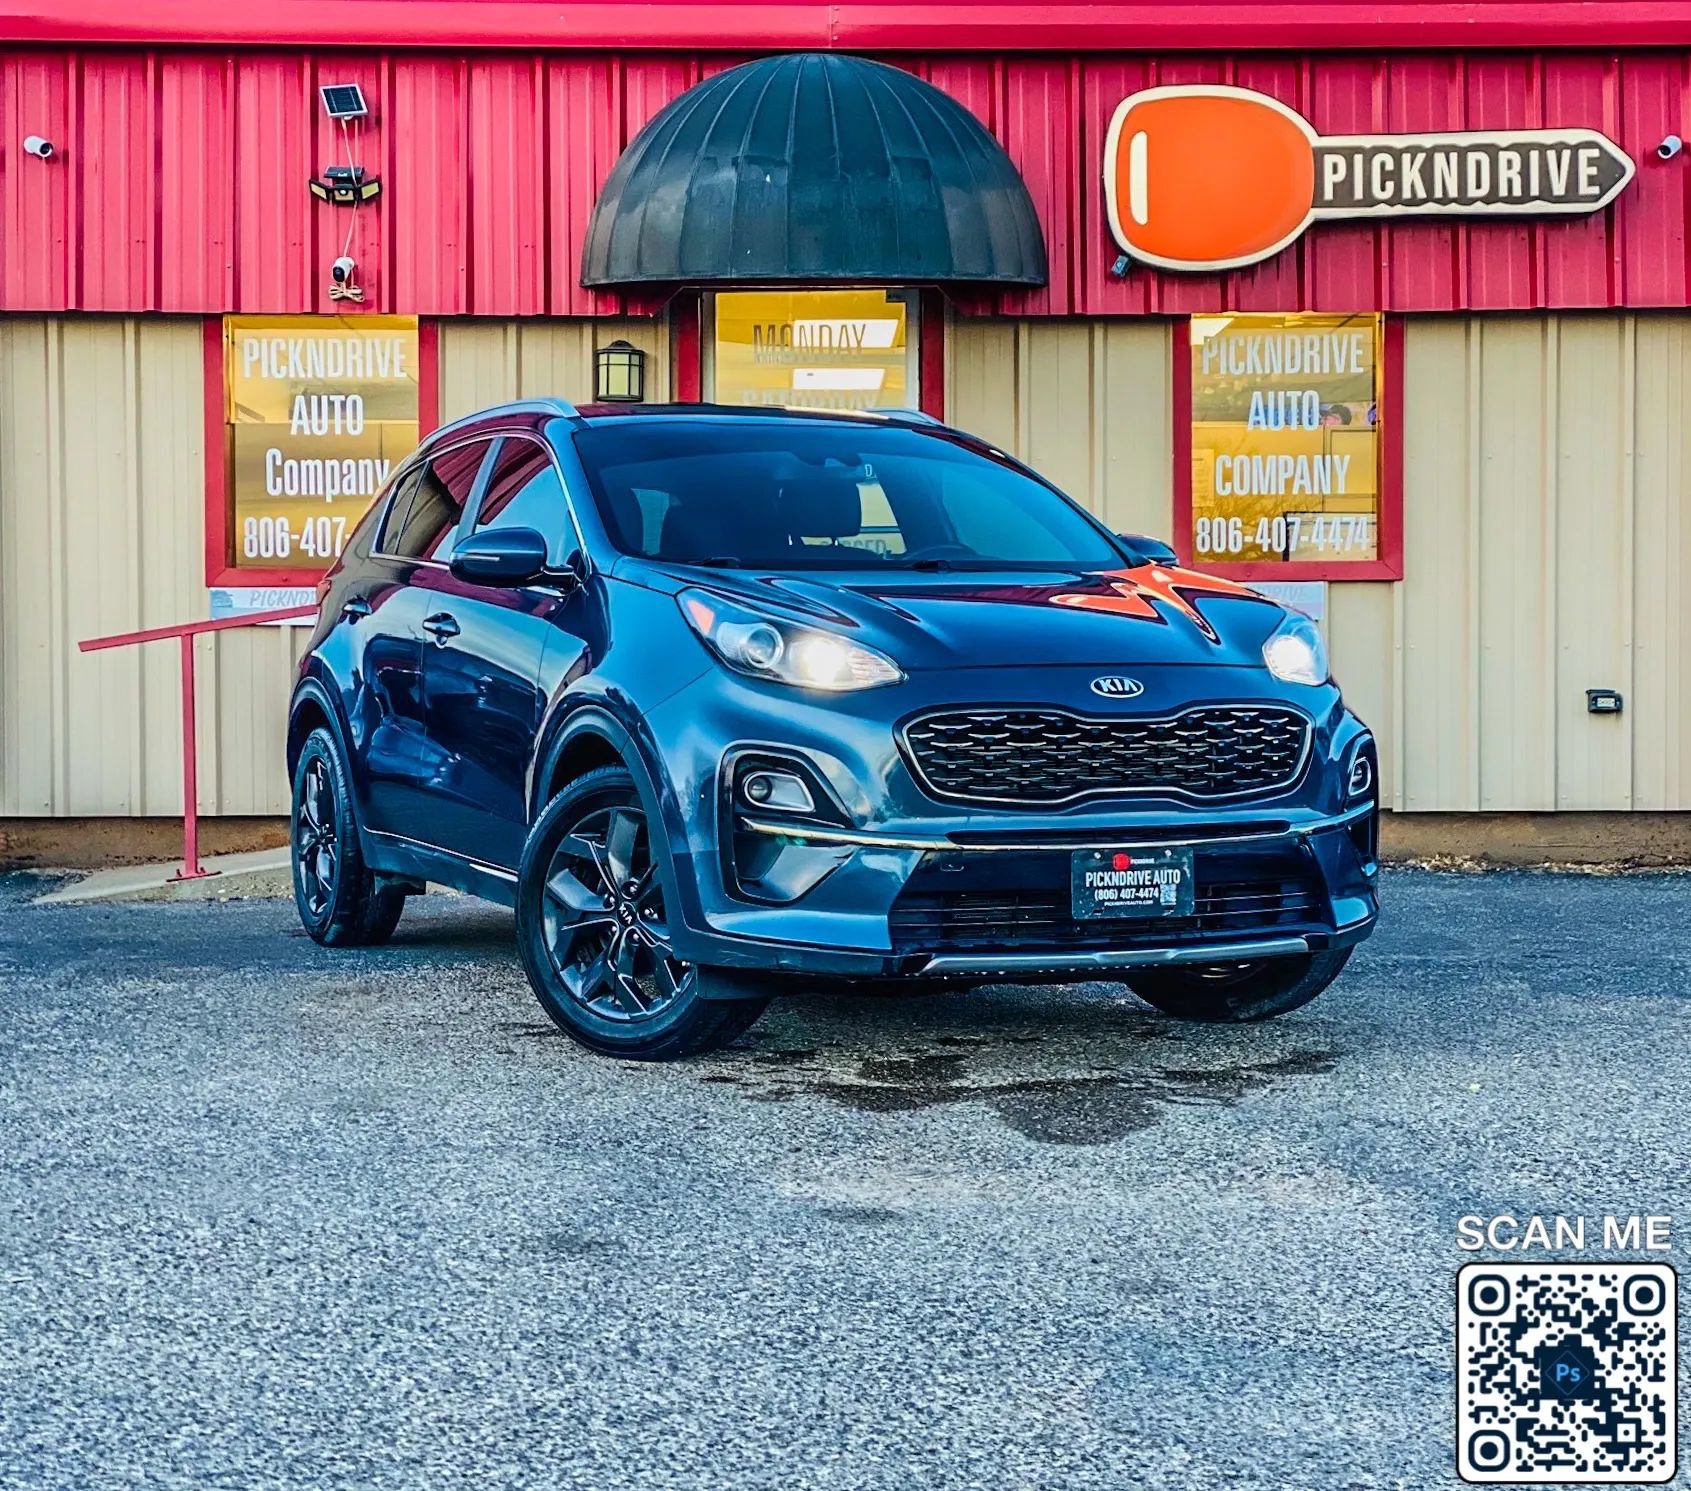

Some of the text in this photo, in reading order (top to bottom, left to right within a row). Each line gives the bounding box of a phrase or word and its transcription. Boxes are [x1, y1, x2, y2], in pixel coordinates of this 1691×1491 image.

[1323, 148, 1601, 200] PICKNDRIVE
[243, 338, 407, 379] PICKNDRIVE
[753, 323, 866, 360] MONDAY
[1202, 333, 1364, 375] PICKNDRIVE
[290, 394, 364, 436] AUTO
[1248, 389, 1320, 431] AUTO
[265, 448, 390, 502] Company
[1215, 454, 1351, 496] COMPANY
[243, 516, 351, 559] 806-407-
[1196, 516, 1370, 554] 806-407-4474
[250, 590, 316, 607] PICKND
[1098, 678, 1139, 693] KIA
[1085, 868, 1181, 888] PICKNDRIVE AUTO
[1094, 886, 1159, 901] (806) 407-4474
